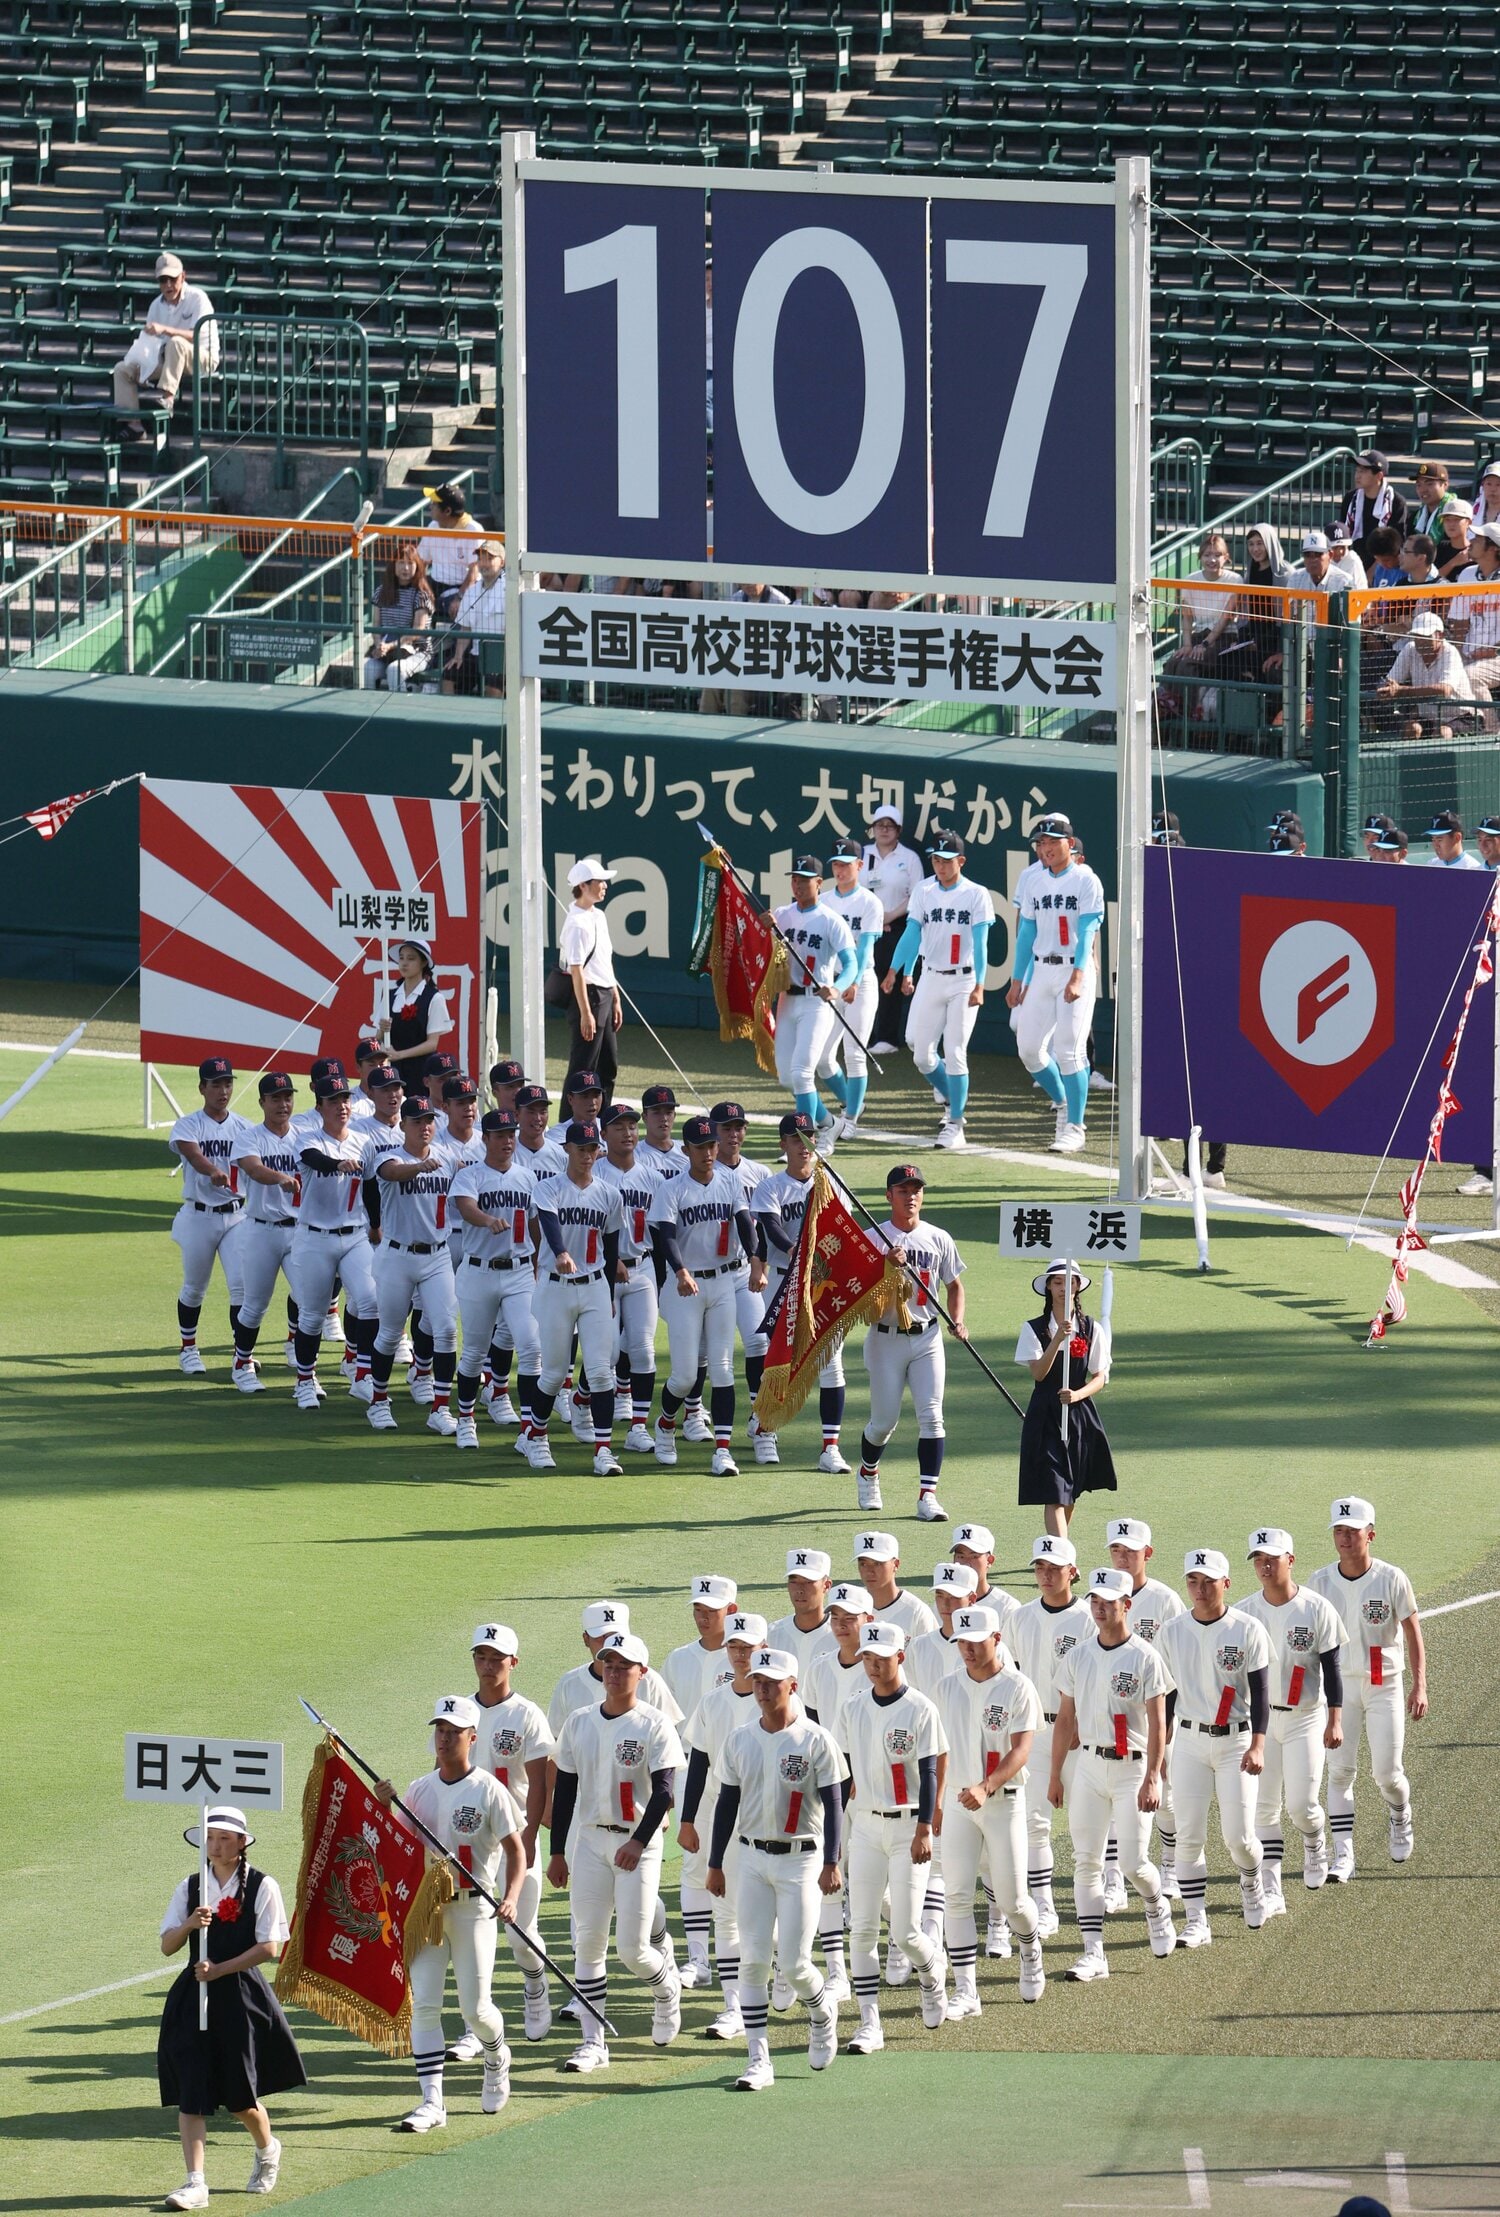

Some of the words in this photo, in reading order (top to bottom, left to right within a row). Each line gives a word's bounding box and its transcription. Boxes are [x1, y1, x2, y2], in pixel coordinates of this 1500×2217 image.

[563, 224, 1089, 538] 107
[538, 606, 1104, 698] 全国高校野球選手権大会
[449, 738, 1049, 845] 水わりって、大切だから
[338, 893, 429, 933] 山梨学院
[1012, 1208, 1128, 1251] 横浜
[1340, 1505, 1350, 1515] N
[961, 1530, 971, 1539] N
[1118, 1524, 1128, 1535] N
[864, 1538, 874, 1548] N
[1257, 1533, 1267, 1544] N
[1042, 1541, 1052, 1551] N
[796, 1554, 806, 1565] N
[1195, 1554, 1205, 1564] N
[943, 1569, 954, 1580] N
[1096, 1573, 1106, 1583] N
[700, 1581, 710, 1592] N
[837, 1589, 847, 1599] N
[604, 1611, 614, 1621] N
[960, 1616, 970, 1627] N
[734, 1619, 745, 1630] N
[485, 1628, 497, 1639] N
[868, 1630, 878, 1640] N
[613, 1637, 624, 1646] N
[760, 1654, 770, 1665] N
[443, 1701, 455, 1712] N
[137, 1741, 271, 1795] 日大三
